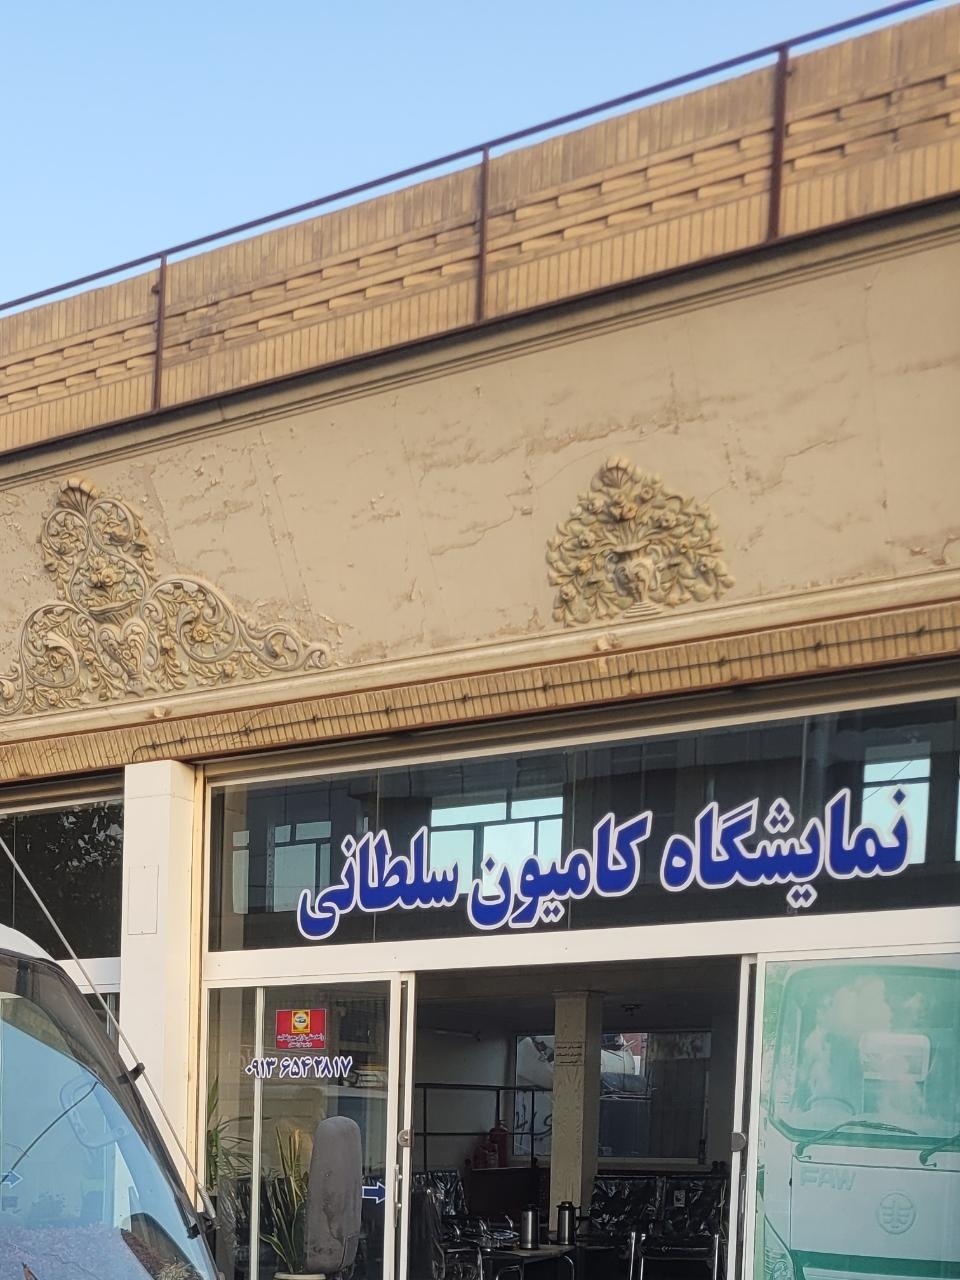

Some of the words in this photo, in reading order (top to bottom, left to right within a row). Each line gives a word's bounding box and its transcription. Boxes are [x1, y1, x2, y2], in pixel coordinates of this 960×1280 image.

[297, 826, 461, 940] سلطانی
[467, 811, 653, 930] کامیون
[660, 785, 910, 908] نمایشگاه
[799, 1167, 857, 1191] FAW
